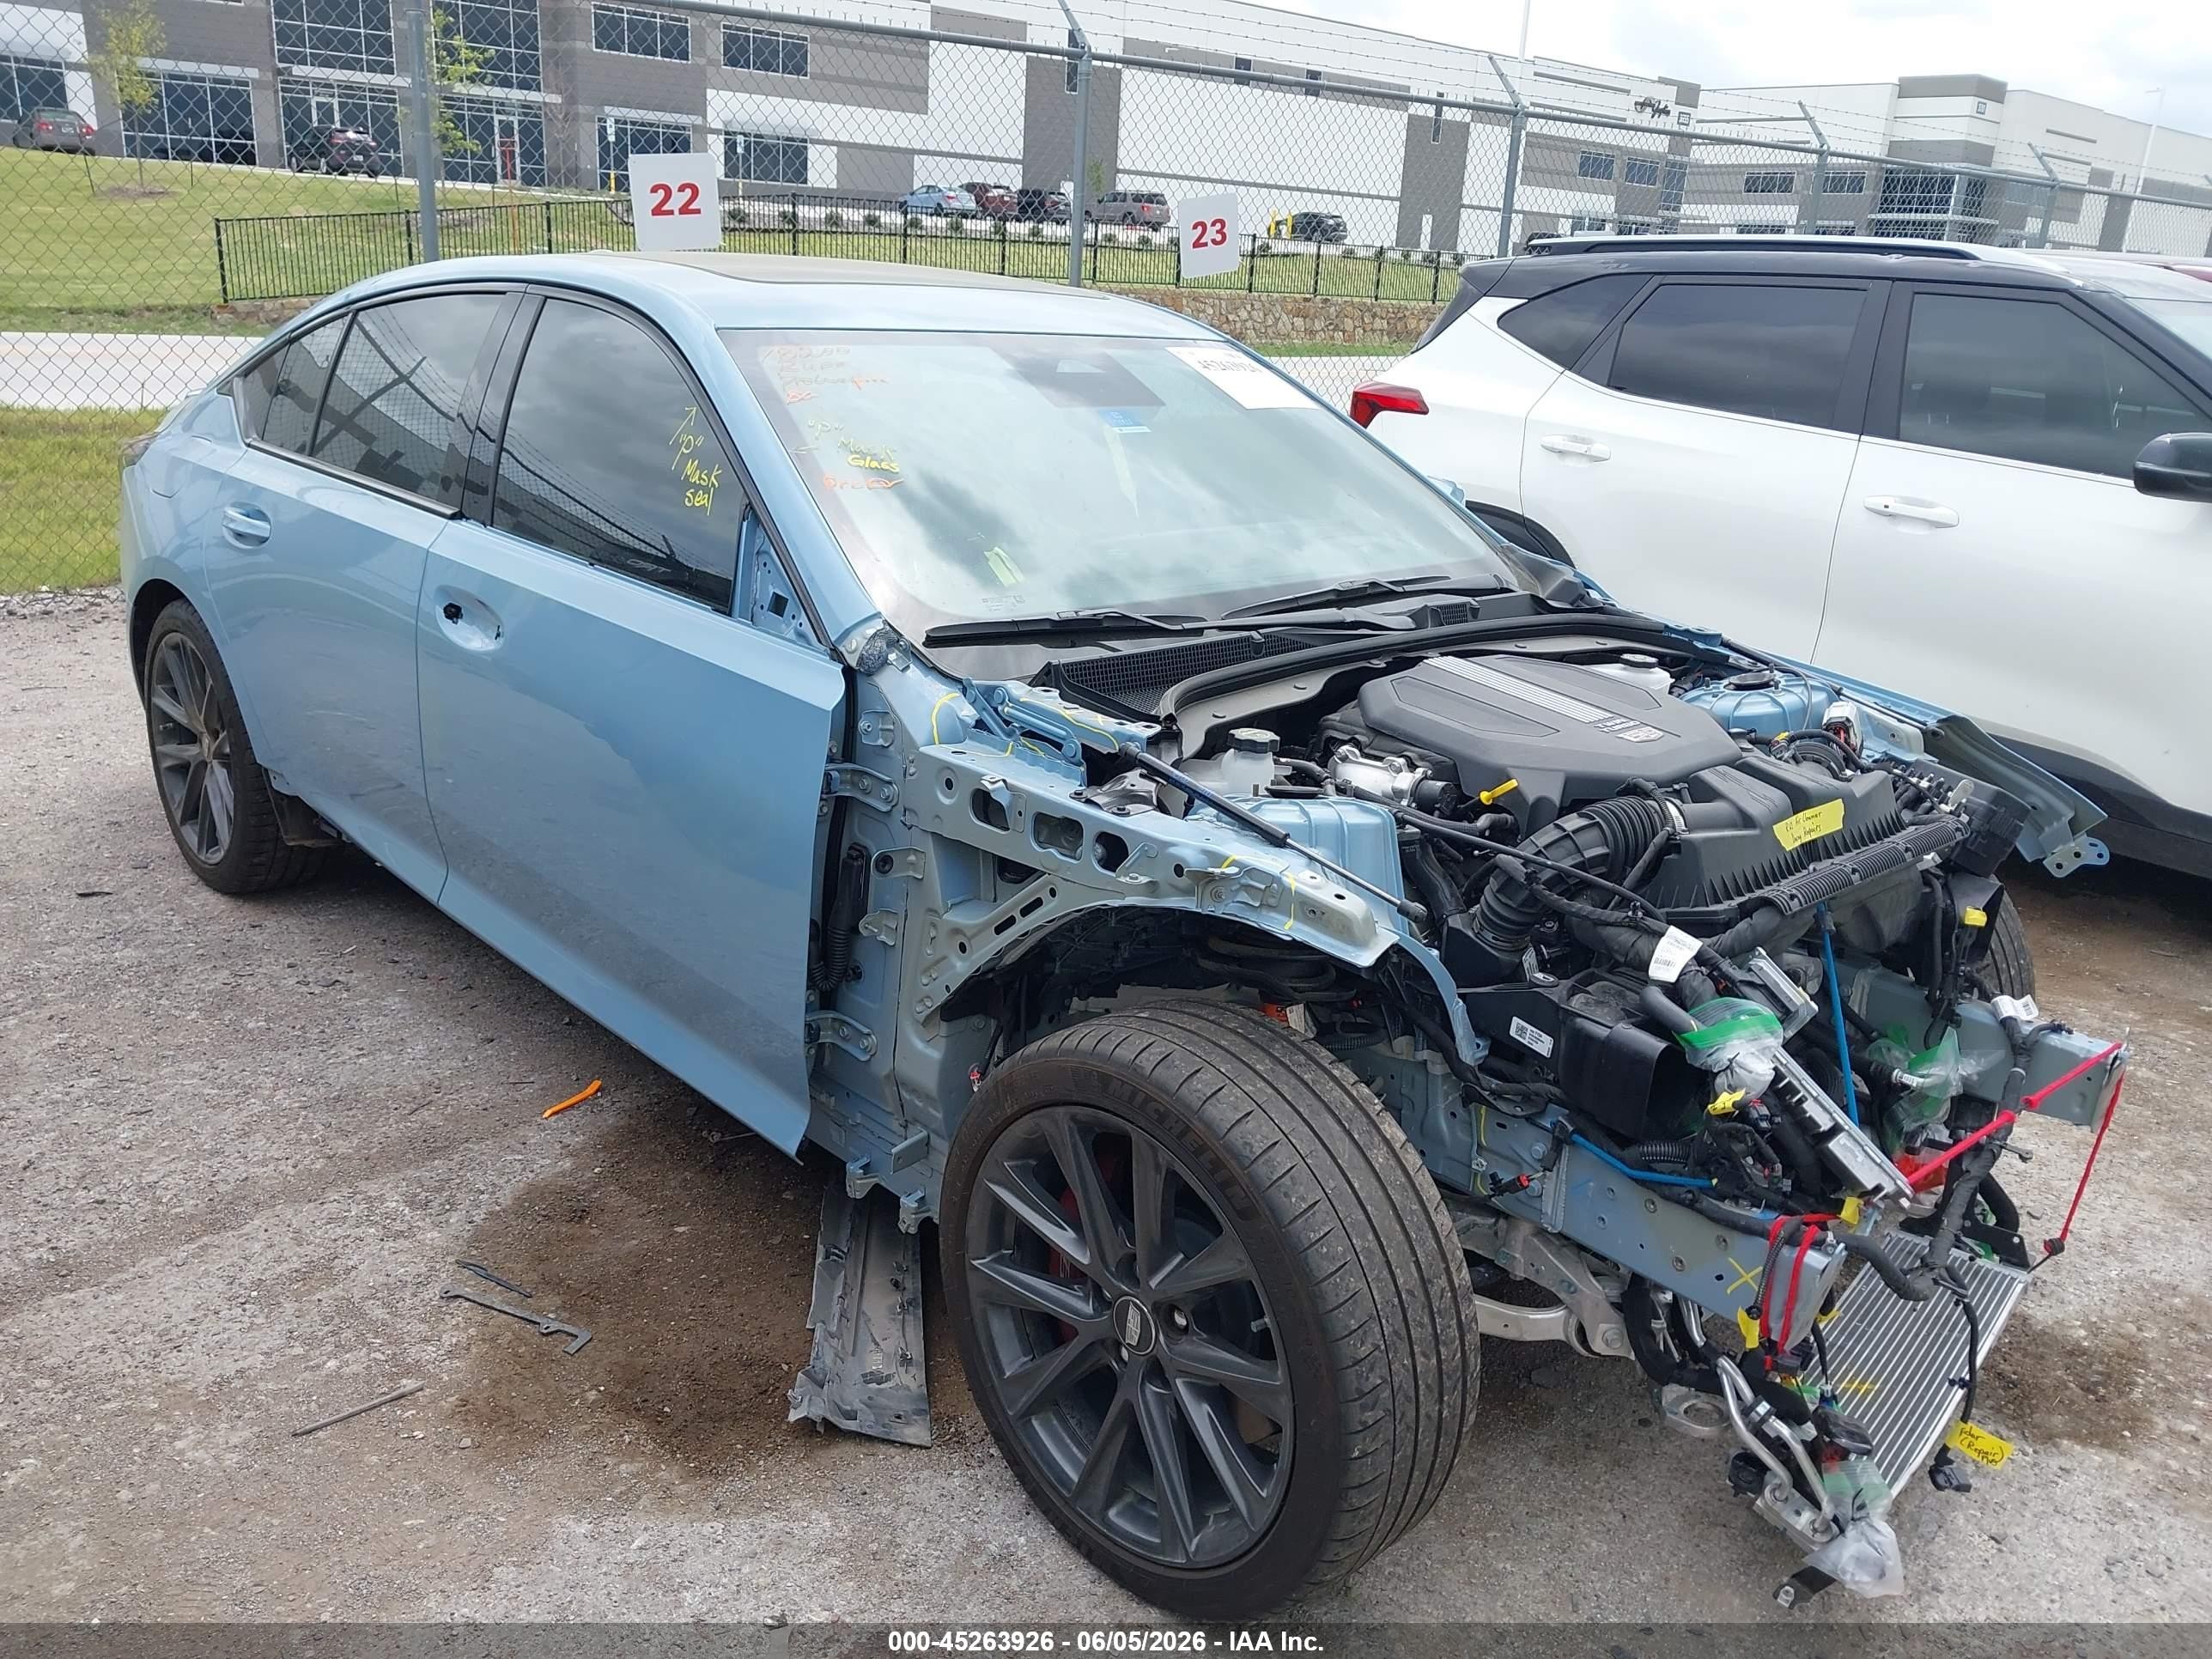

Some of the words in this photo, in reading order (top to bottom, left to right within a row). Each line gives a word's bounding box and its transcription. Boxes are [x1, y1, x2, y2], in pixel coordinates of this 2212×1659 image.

[649, 182, 702, 216] 22
[1191, 218, 1228, 249] 23
[681, 459, 722, 488] Mask
[847, 454, 900, 473] Glass
[1109, 1078, 1257, 1216] MICHELIN
